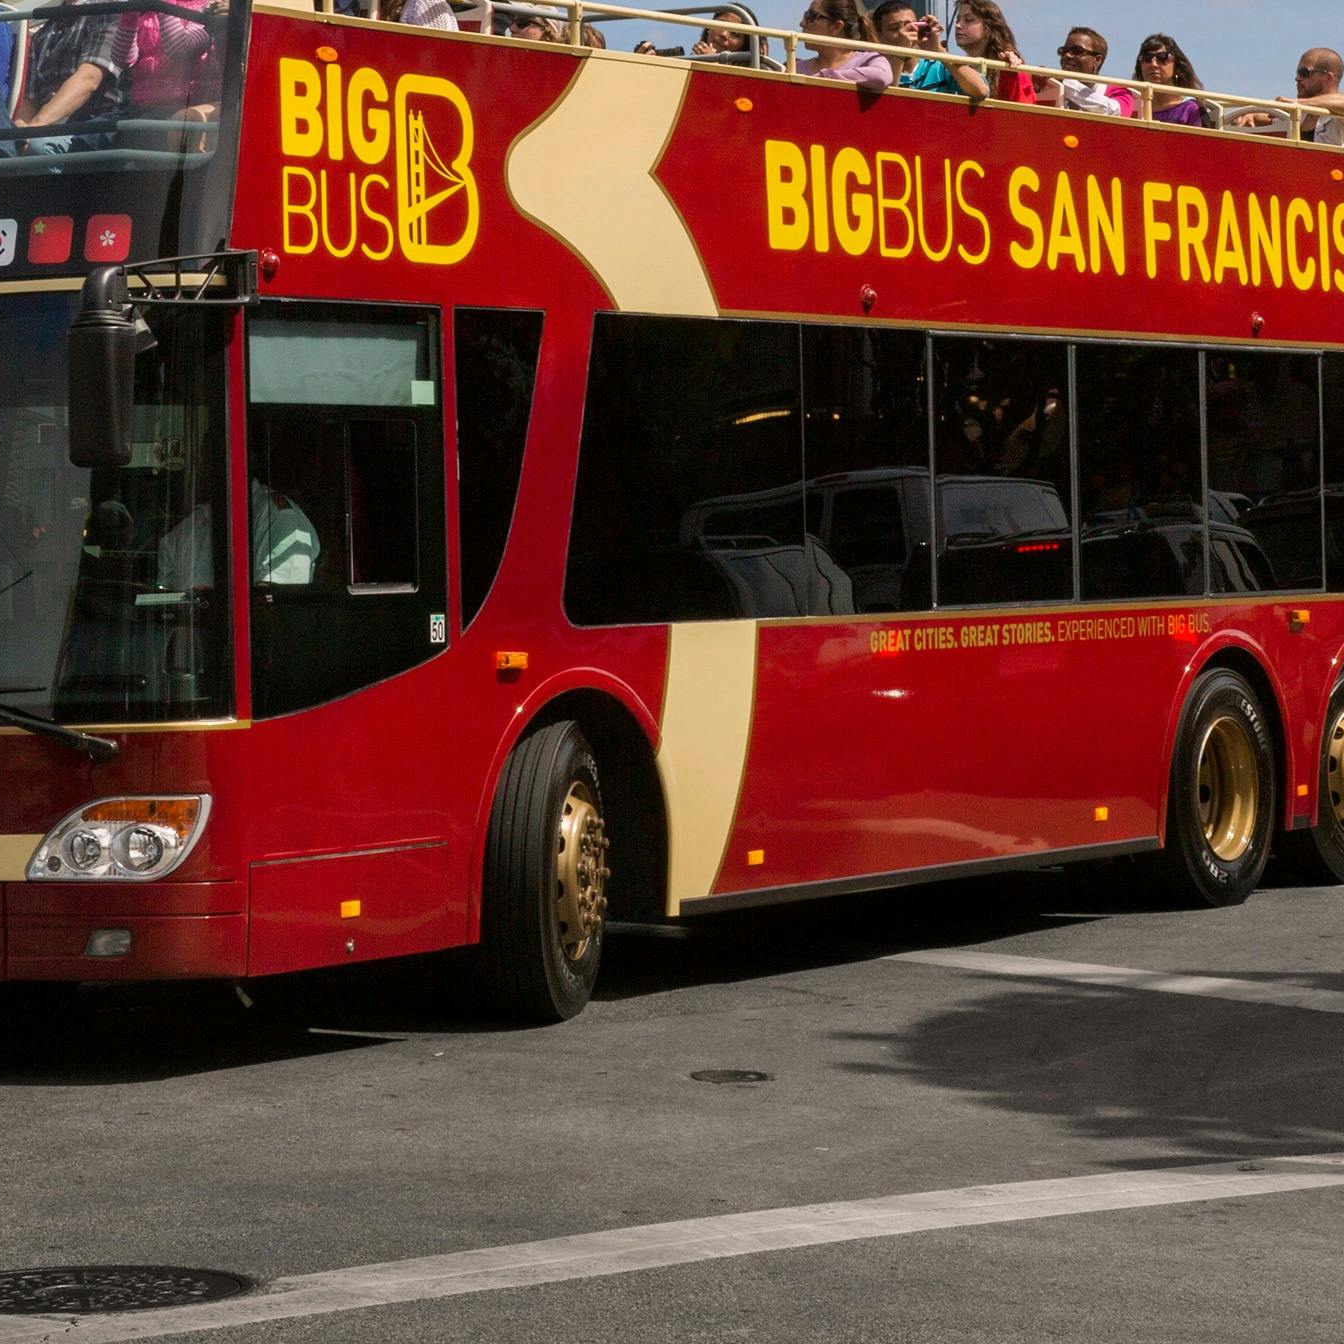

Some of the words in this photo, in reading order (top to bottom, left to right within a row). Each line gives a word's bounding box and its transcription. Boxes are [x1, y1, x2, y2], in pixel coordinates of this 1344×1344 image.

[279, 57, 391, 165] BIG
[283, 165, 394, 261] BUS
[1008, 166, 1126, 276] SAN
[432, 622, 444, 641] 50
[870, 629, 911, 653] GREAT
[914, 627, 958, 650] CITIES.
[961, 624, 1000, 647] GREAT
[1002, 621, 1055, 646] STORIES.
[1057, 617, 1135, 642] EXPERIENCED
[1137, 615, 1165, 637] WITH
[1168, 614, 1186, 636] BIG
[1188, 612, 1213, 633] BUS.
